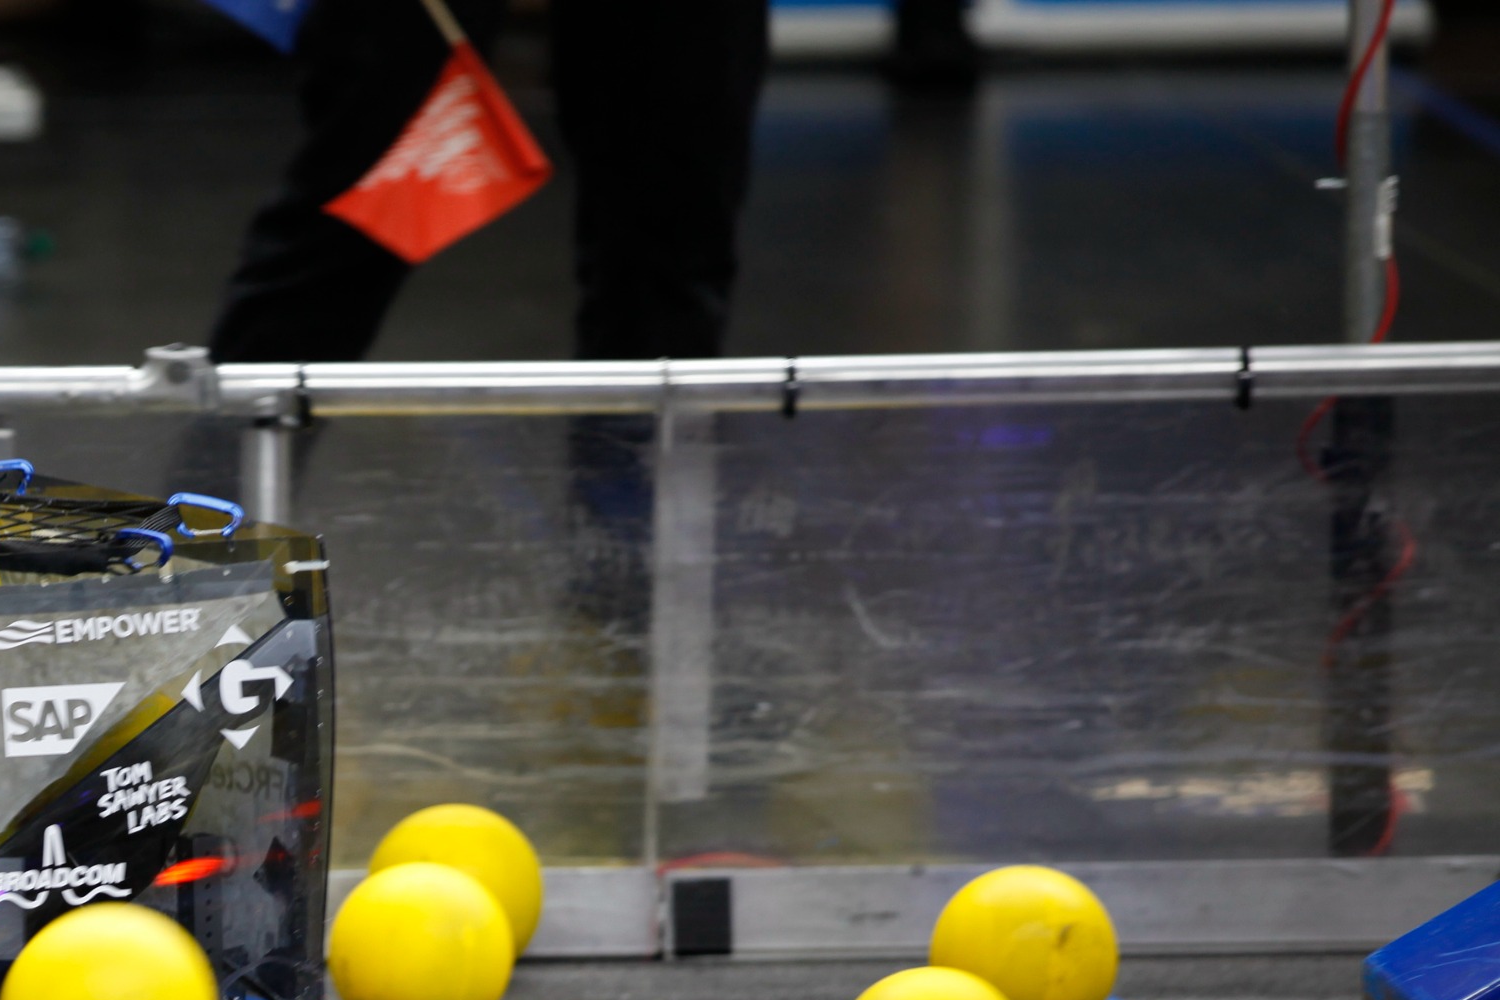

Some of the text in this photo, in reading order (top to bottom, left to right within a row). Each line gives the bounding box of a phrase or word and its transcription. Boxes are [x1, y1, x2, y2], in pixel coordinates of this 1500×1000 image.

[55, 607, 201, 644] EMPOWER
[8, 698, 93, 743] SAP
[100, 761, 153, 793] TOM
[97, 776, 192, 818] SAWYER
[127, 798, 188, 834] LABS
